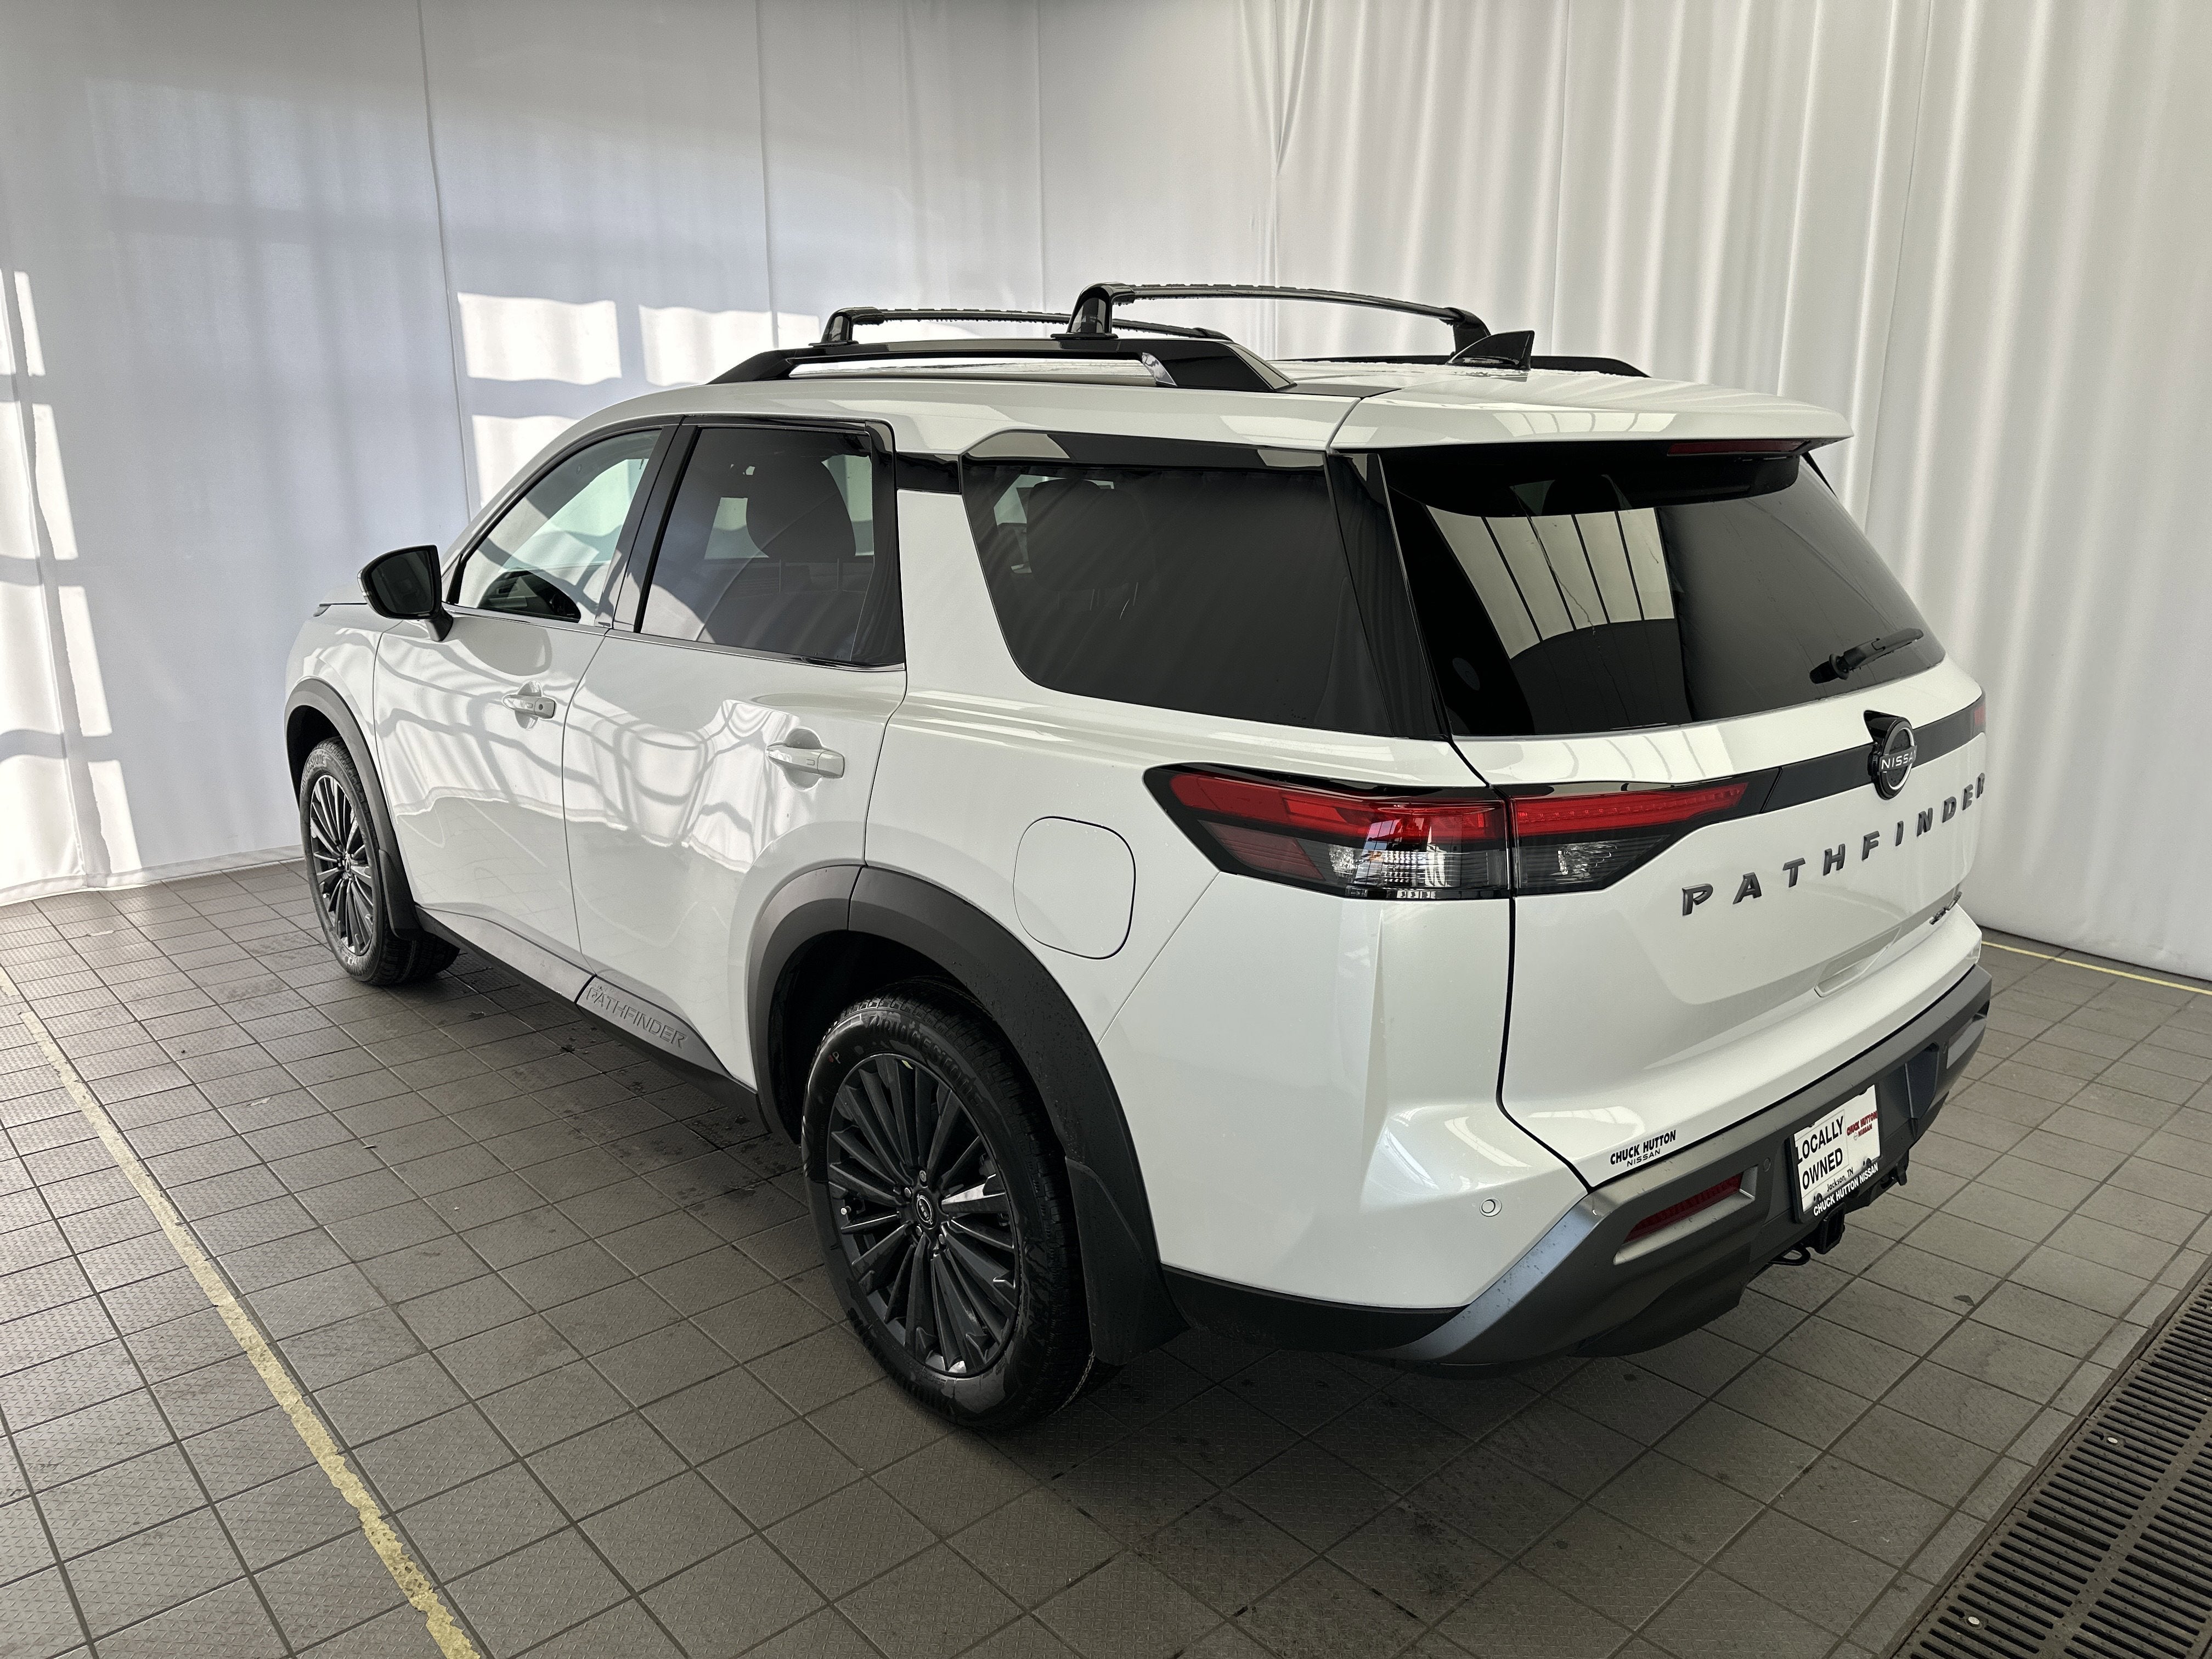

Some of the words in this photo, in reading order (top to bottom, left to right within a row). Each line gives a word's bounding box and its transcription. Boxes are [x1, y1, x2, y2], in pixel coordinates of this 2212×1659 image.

[1681, 772, 1985, 916] PATHFINDER
[586, 986, 687, 1049] PATHFINDER
[1610, 1144, 1640, 1165] CHUCK
[1643, 1130, 1677, 1153] HUTTON
[1627, 1148, 1661, 1167] NISSAN
[1795, 1115, 1843, 1164] LOCALLY
[1802, 1148, 1843, 1190] OWNED
[1813, 1194, 1836, 1216] CHUCK
[1836, 1177, 1859, 1201] HUTTON
[1859, 1162, 1879, 1184] NISSAN
